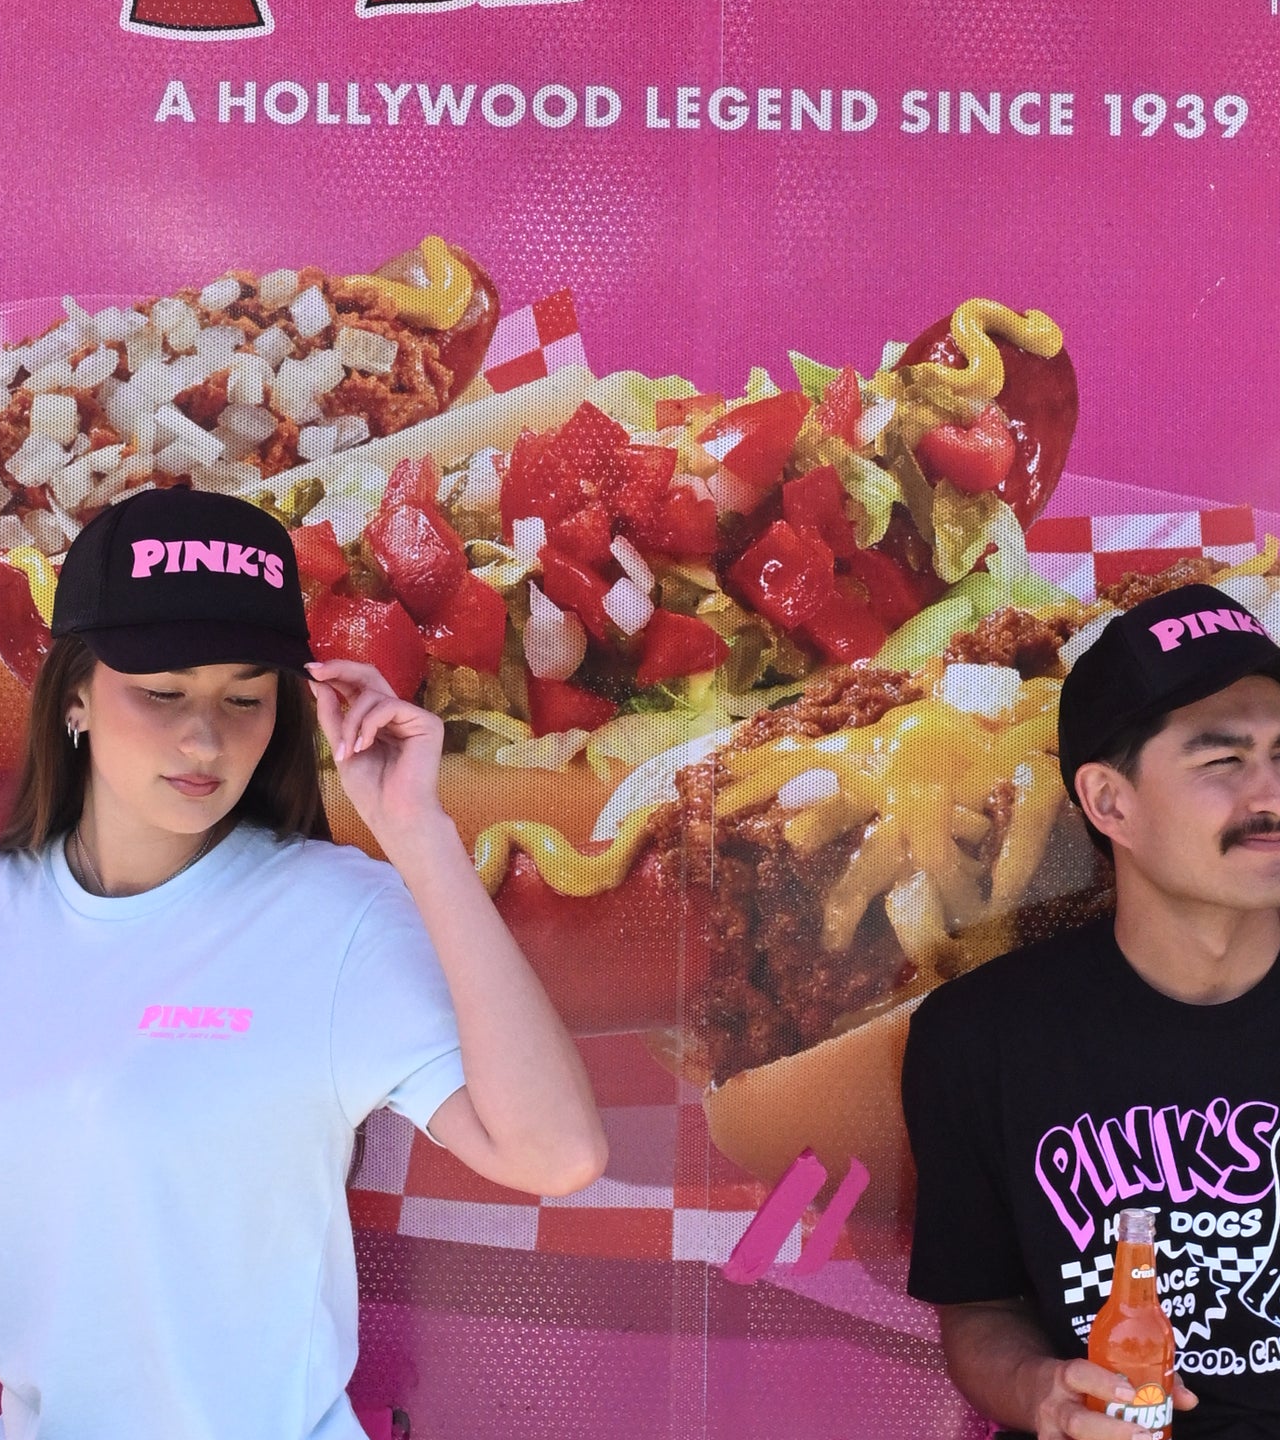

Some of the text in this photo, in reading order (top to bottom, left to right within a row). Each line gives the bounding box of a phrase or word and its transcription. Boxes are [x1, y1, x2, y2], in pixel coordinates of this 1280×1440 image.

[154, 80, 1250, 140] A HOLLYWOOD LEGEND SINCE 1939
[130, 538, 284, 589] PINK'S
[1148, 608, 1276, 652] PINK
[138, 1004, 254, 1033] PINK'S
[1035, 1097, 1280, 1253] PINK'S
[1170, 1208, 1263, 1238] DOGS
[1156, 1266, 1200, 1295] NCE
[1160, 1292, 1196, 1318] 939
